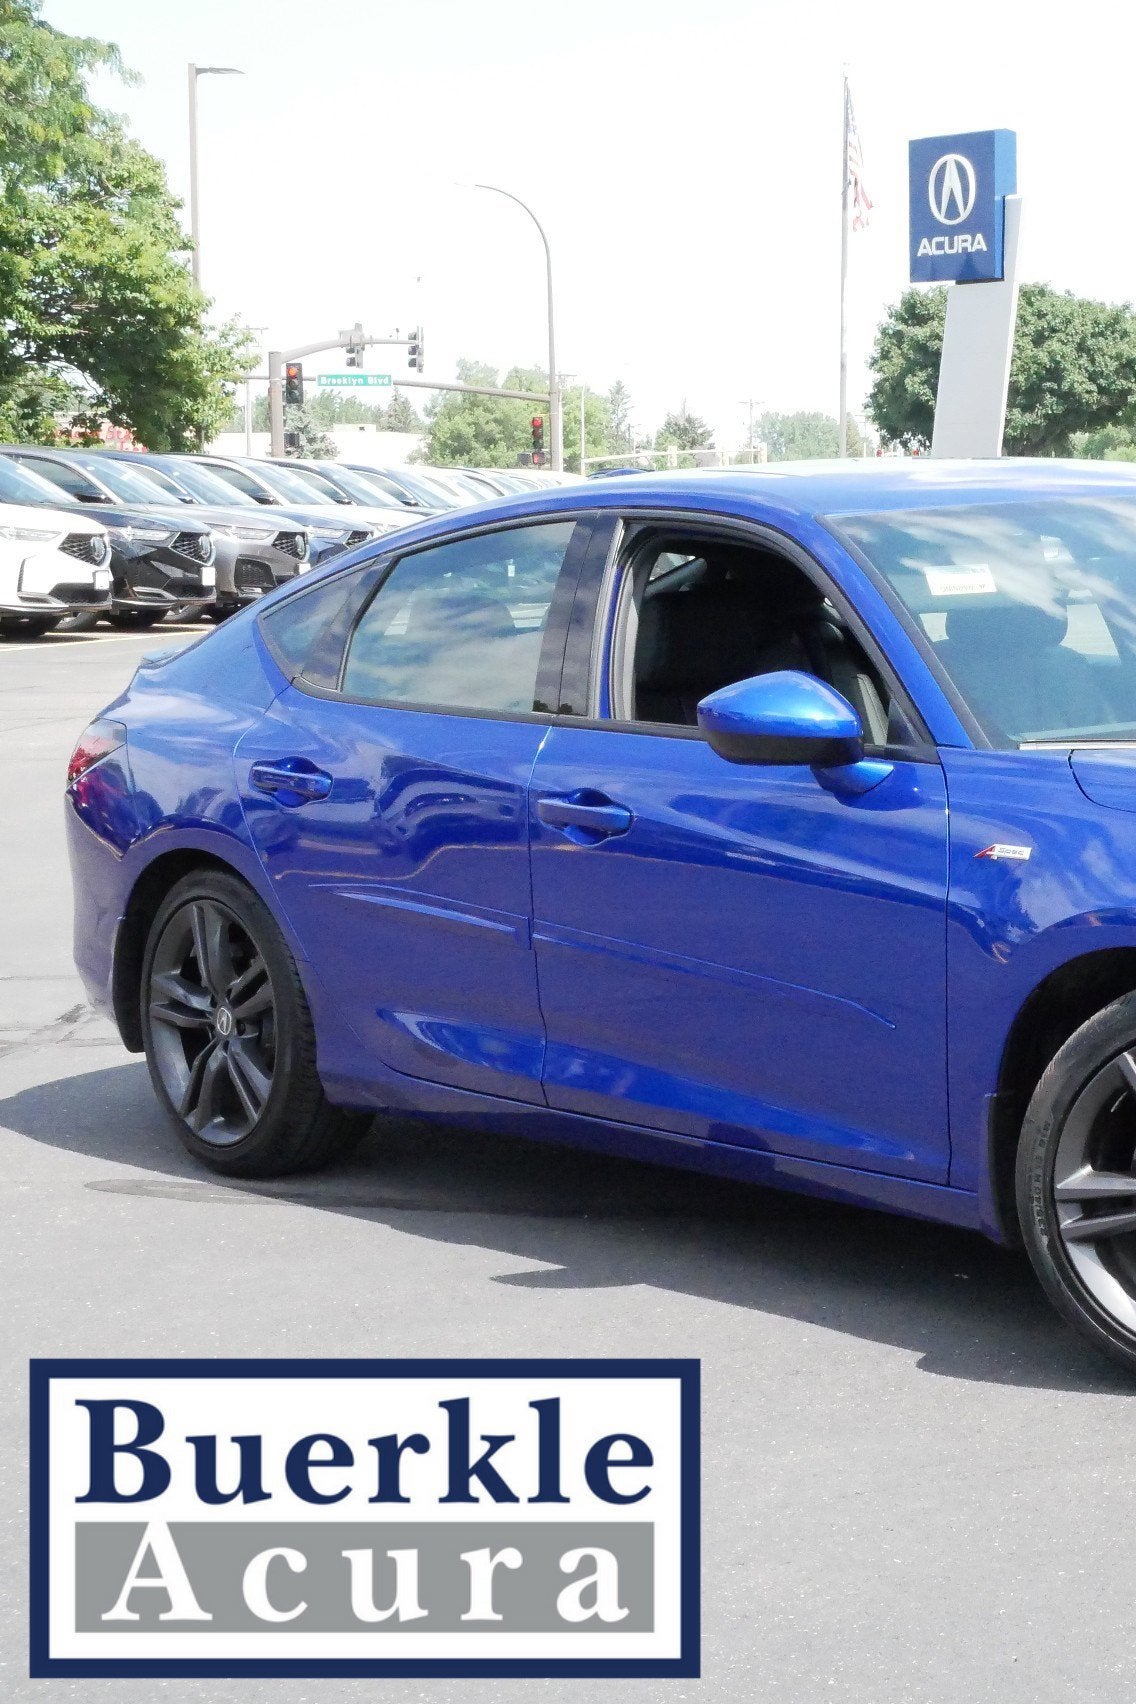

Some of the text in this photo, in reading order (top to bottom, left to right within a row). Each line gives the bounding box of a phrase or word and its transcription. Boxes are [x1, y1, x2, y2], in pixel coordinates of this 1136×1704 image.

[917, 233, 987, 257] ACURA
[320, 376, 389, 386] Brooklyn Blvd
